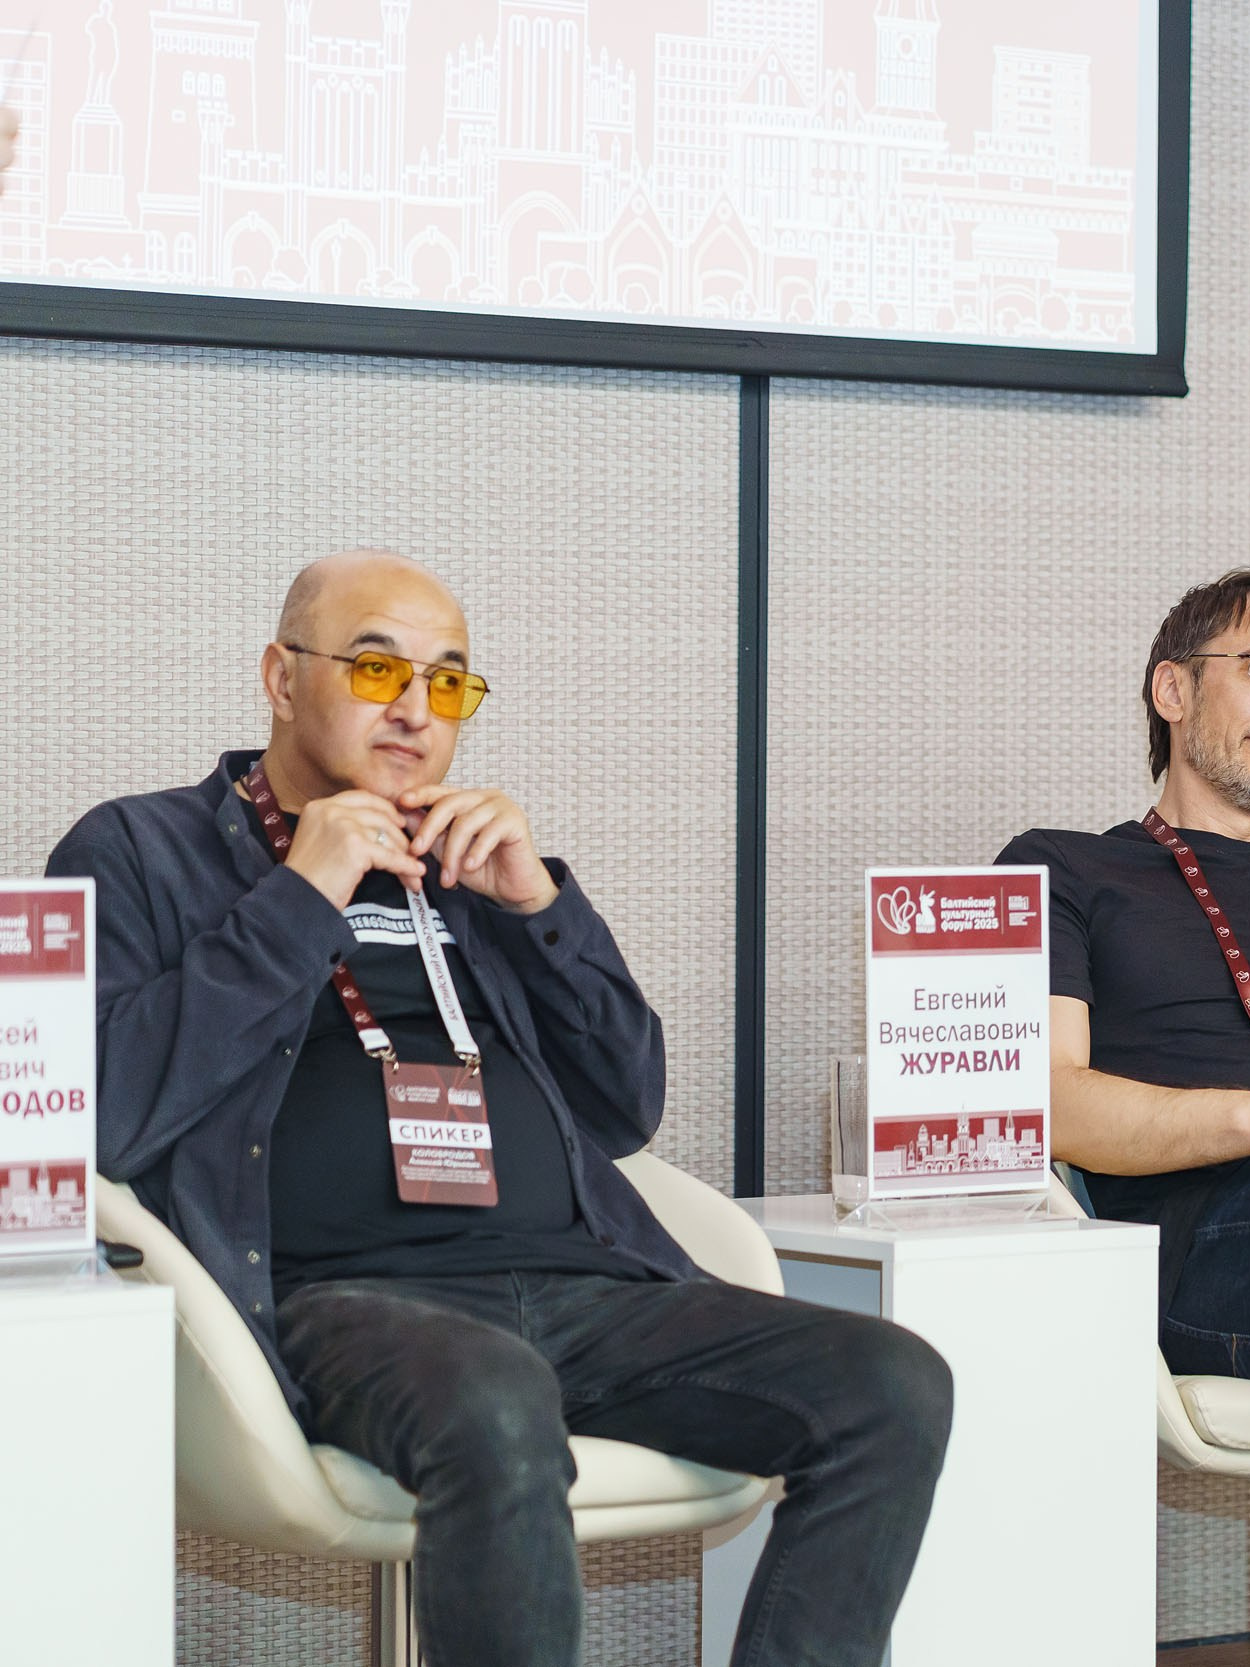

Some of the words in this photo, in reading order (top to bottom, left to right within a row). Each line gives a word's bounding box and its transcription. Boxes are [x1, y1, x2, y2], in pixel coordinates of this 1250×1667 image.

[941, 896, 996, 909] Балтийский
[941, 908, 995, 921] культурный
[941, 919, 973, 932] форум
[974, 917, 999, 930] 2025
[914, 984, 1007, 1011] Евгений
[0, 1016, 37, 1045] ей
[879, 1021, 1041, 1045] Вячеславович
[0, 1059, 44, 1080] вич
[899, 1049, 1021, 1076] ЖУРАВЛИ
[2, 1087, 85, 1119] ОДОВ
[399, 1125, 483, 1143] СПИКЕР
